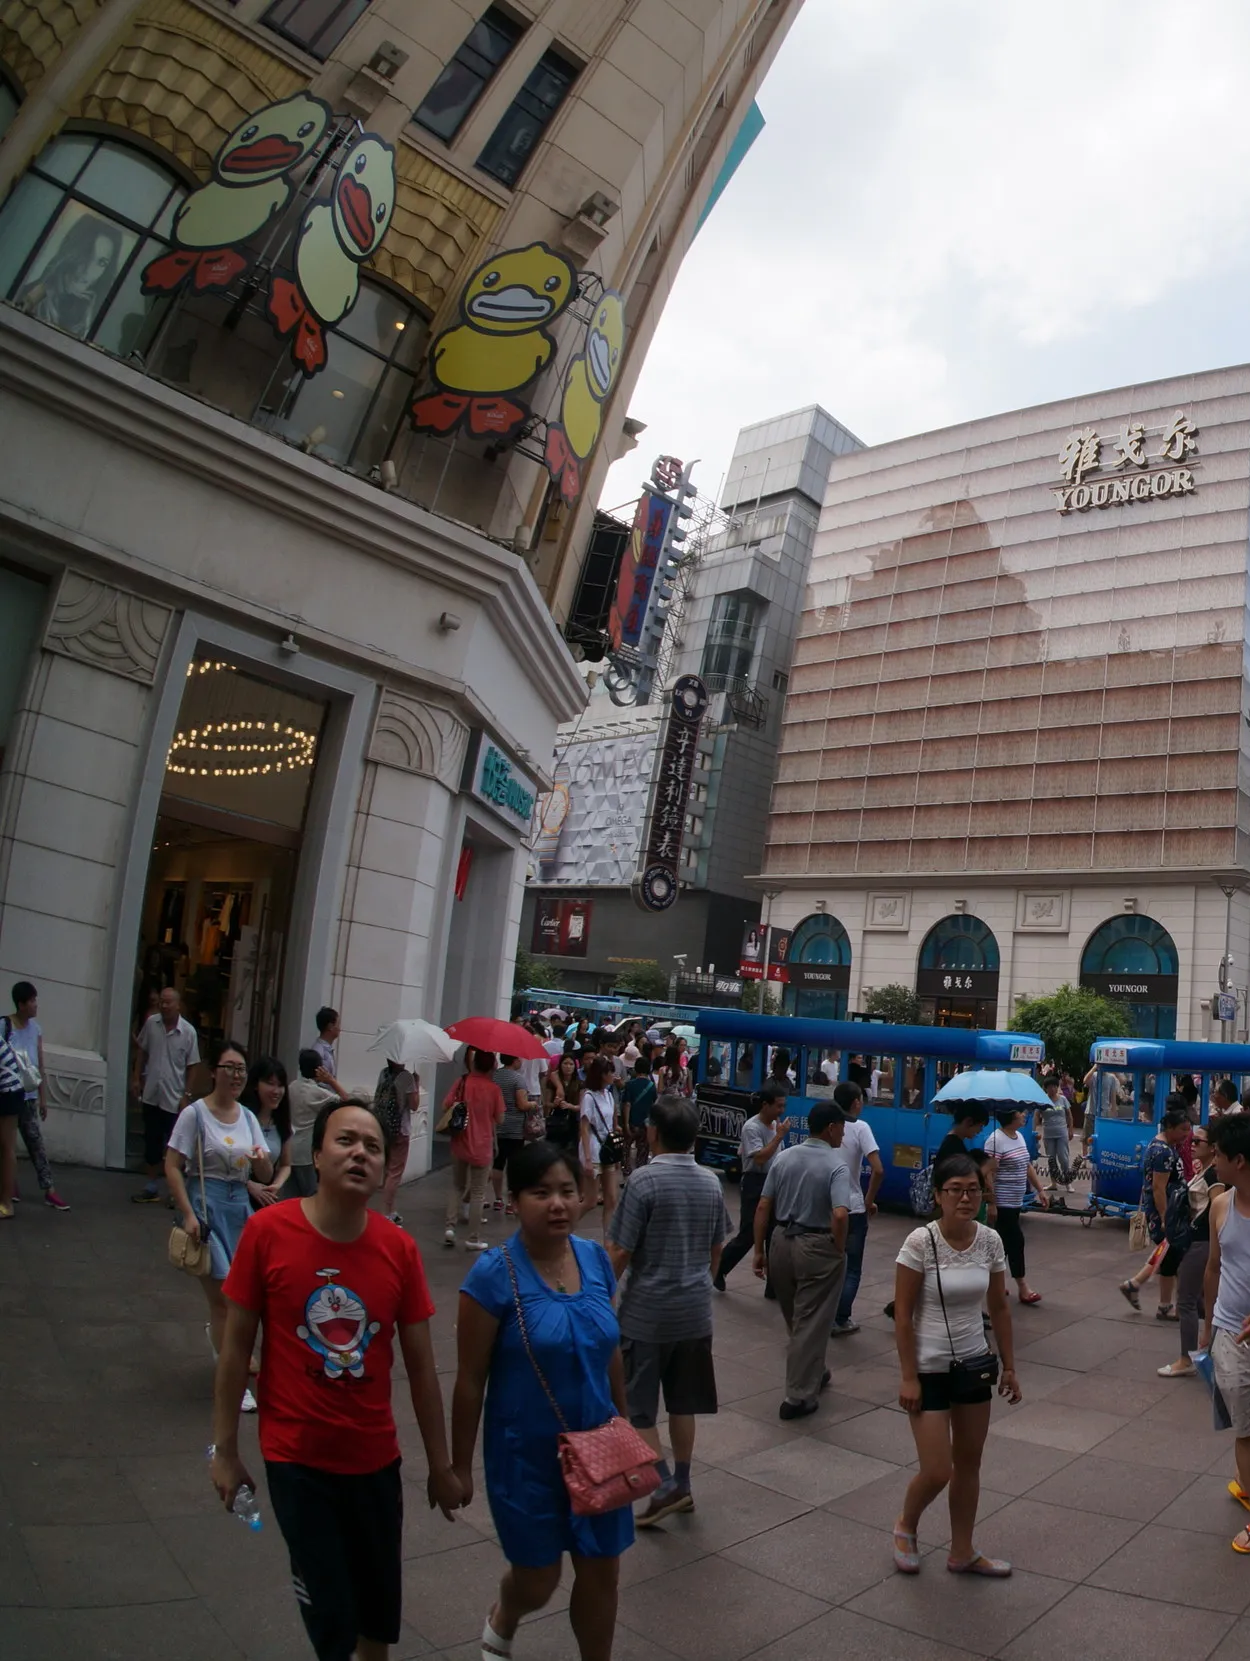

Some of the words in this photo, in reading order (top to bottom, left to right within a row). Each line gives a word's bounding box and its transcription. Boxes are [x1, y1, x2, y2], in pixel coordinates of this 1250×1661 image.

[1058, 409, 1199, 485] 雅戈尔
[1053, 469, 1195, 512] YOUNGOR
[605, 815, 632, 826] OMEGA
[541, 915, 561, 929] Cartier
[804, 971, 832, 982] YOUNGOR
[943, 975, 973, 990] 雅戈尔
[1108, 983, 1148, 995] YOUNGOR
[698, 1104, 745, 1139] ATM
